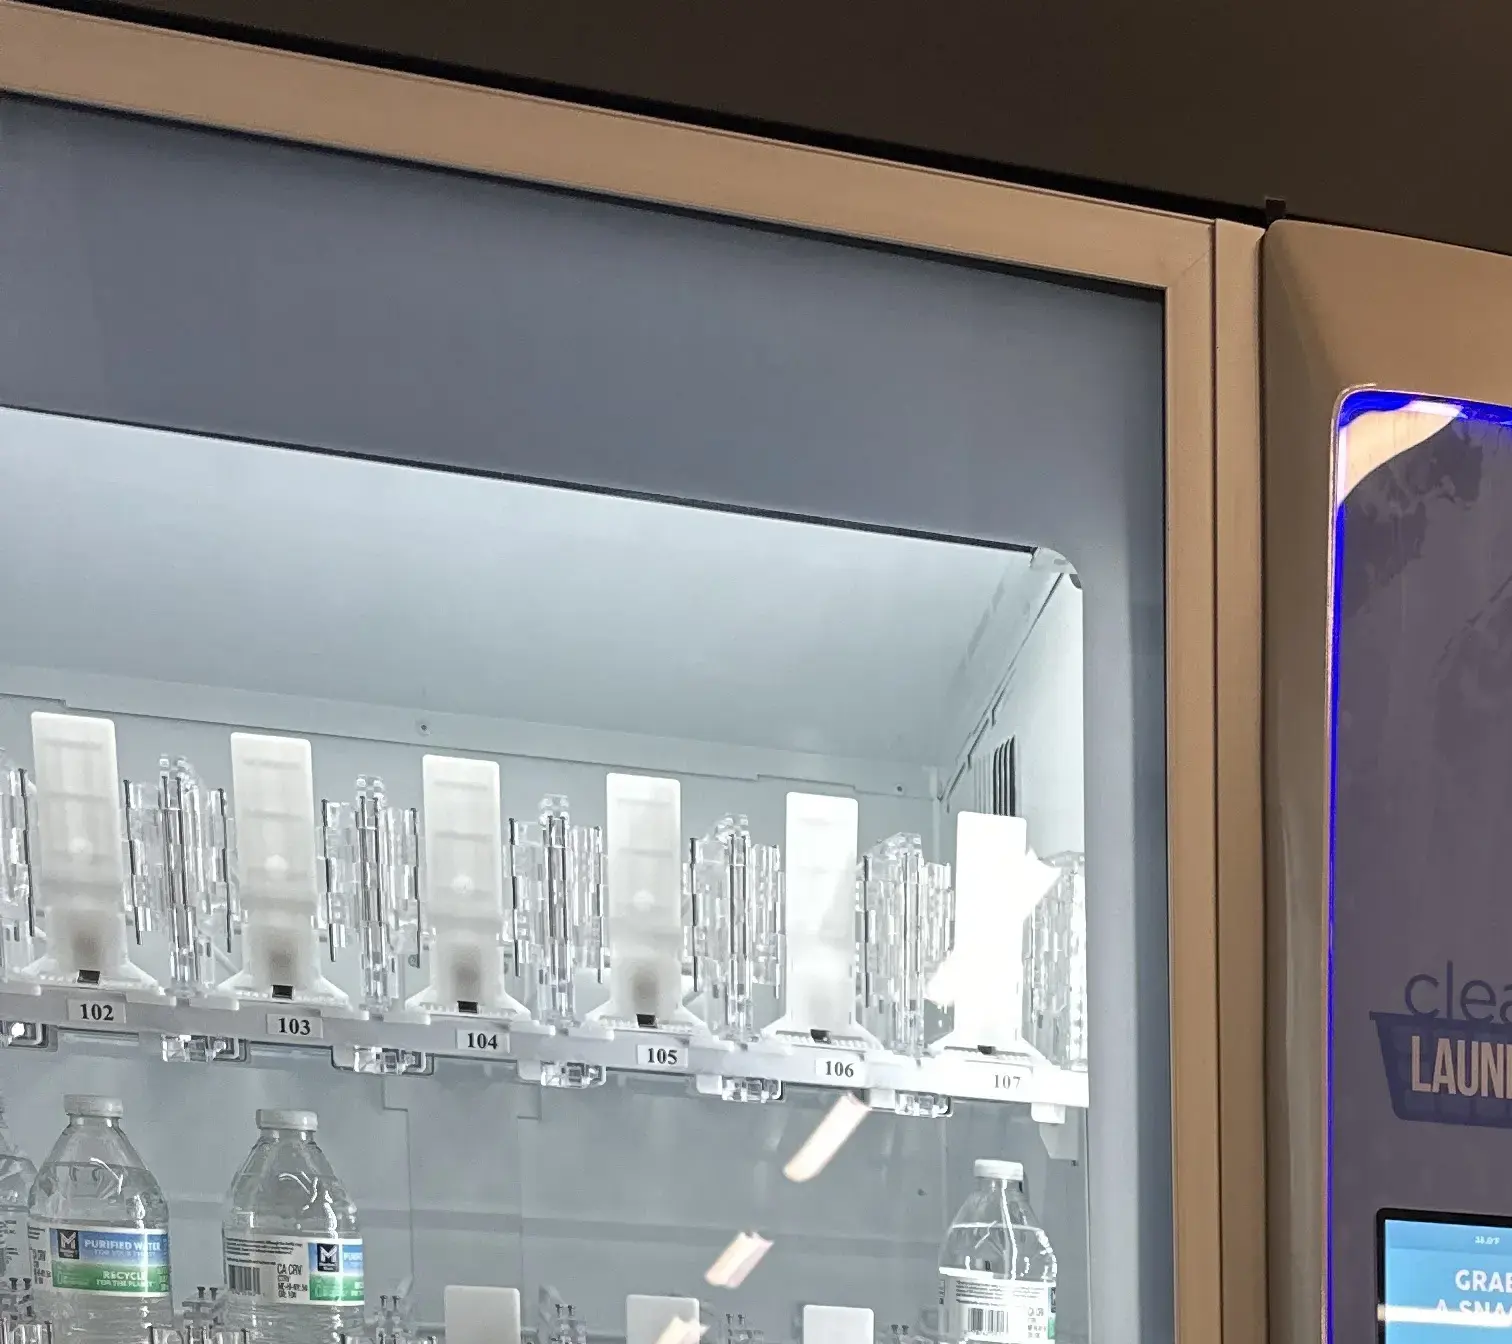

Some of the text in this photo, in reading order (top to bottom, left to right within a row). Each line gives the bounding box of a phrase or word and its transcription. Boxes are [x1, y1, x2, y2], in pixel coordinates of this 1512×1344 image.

[80, 1004, 114, 1020] 102
[278, 1018, 311, 1036] 103
[466, 1032, 498, 1050] 104
[647, 1047, 678, 1065] 105
[825, 1060, 854, 1078] 106
[993, 1073, 1020, 1090] 107
